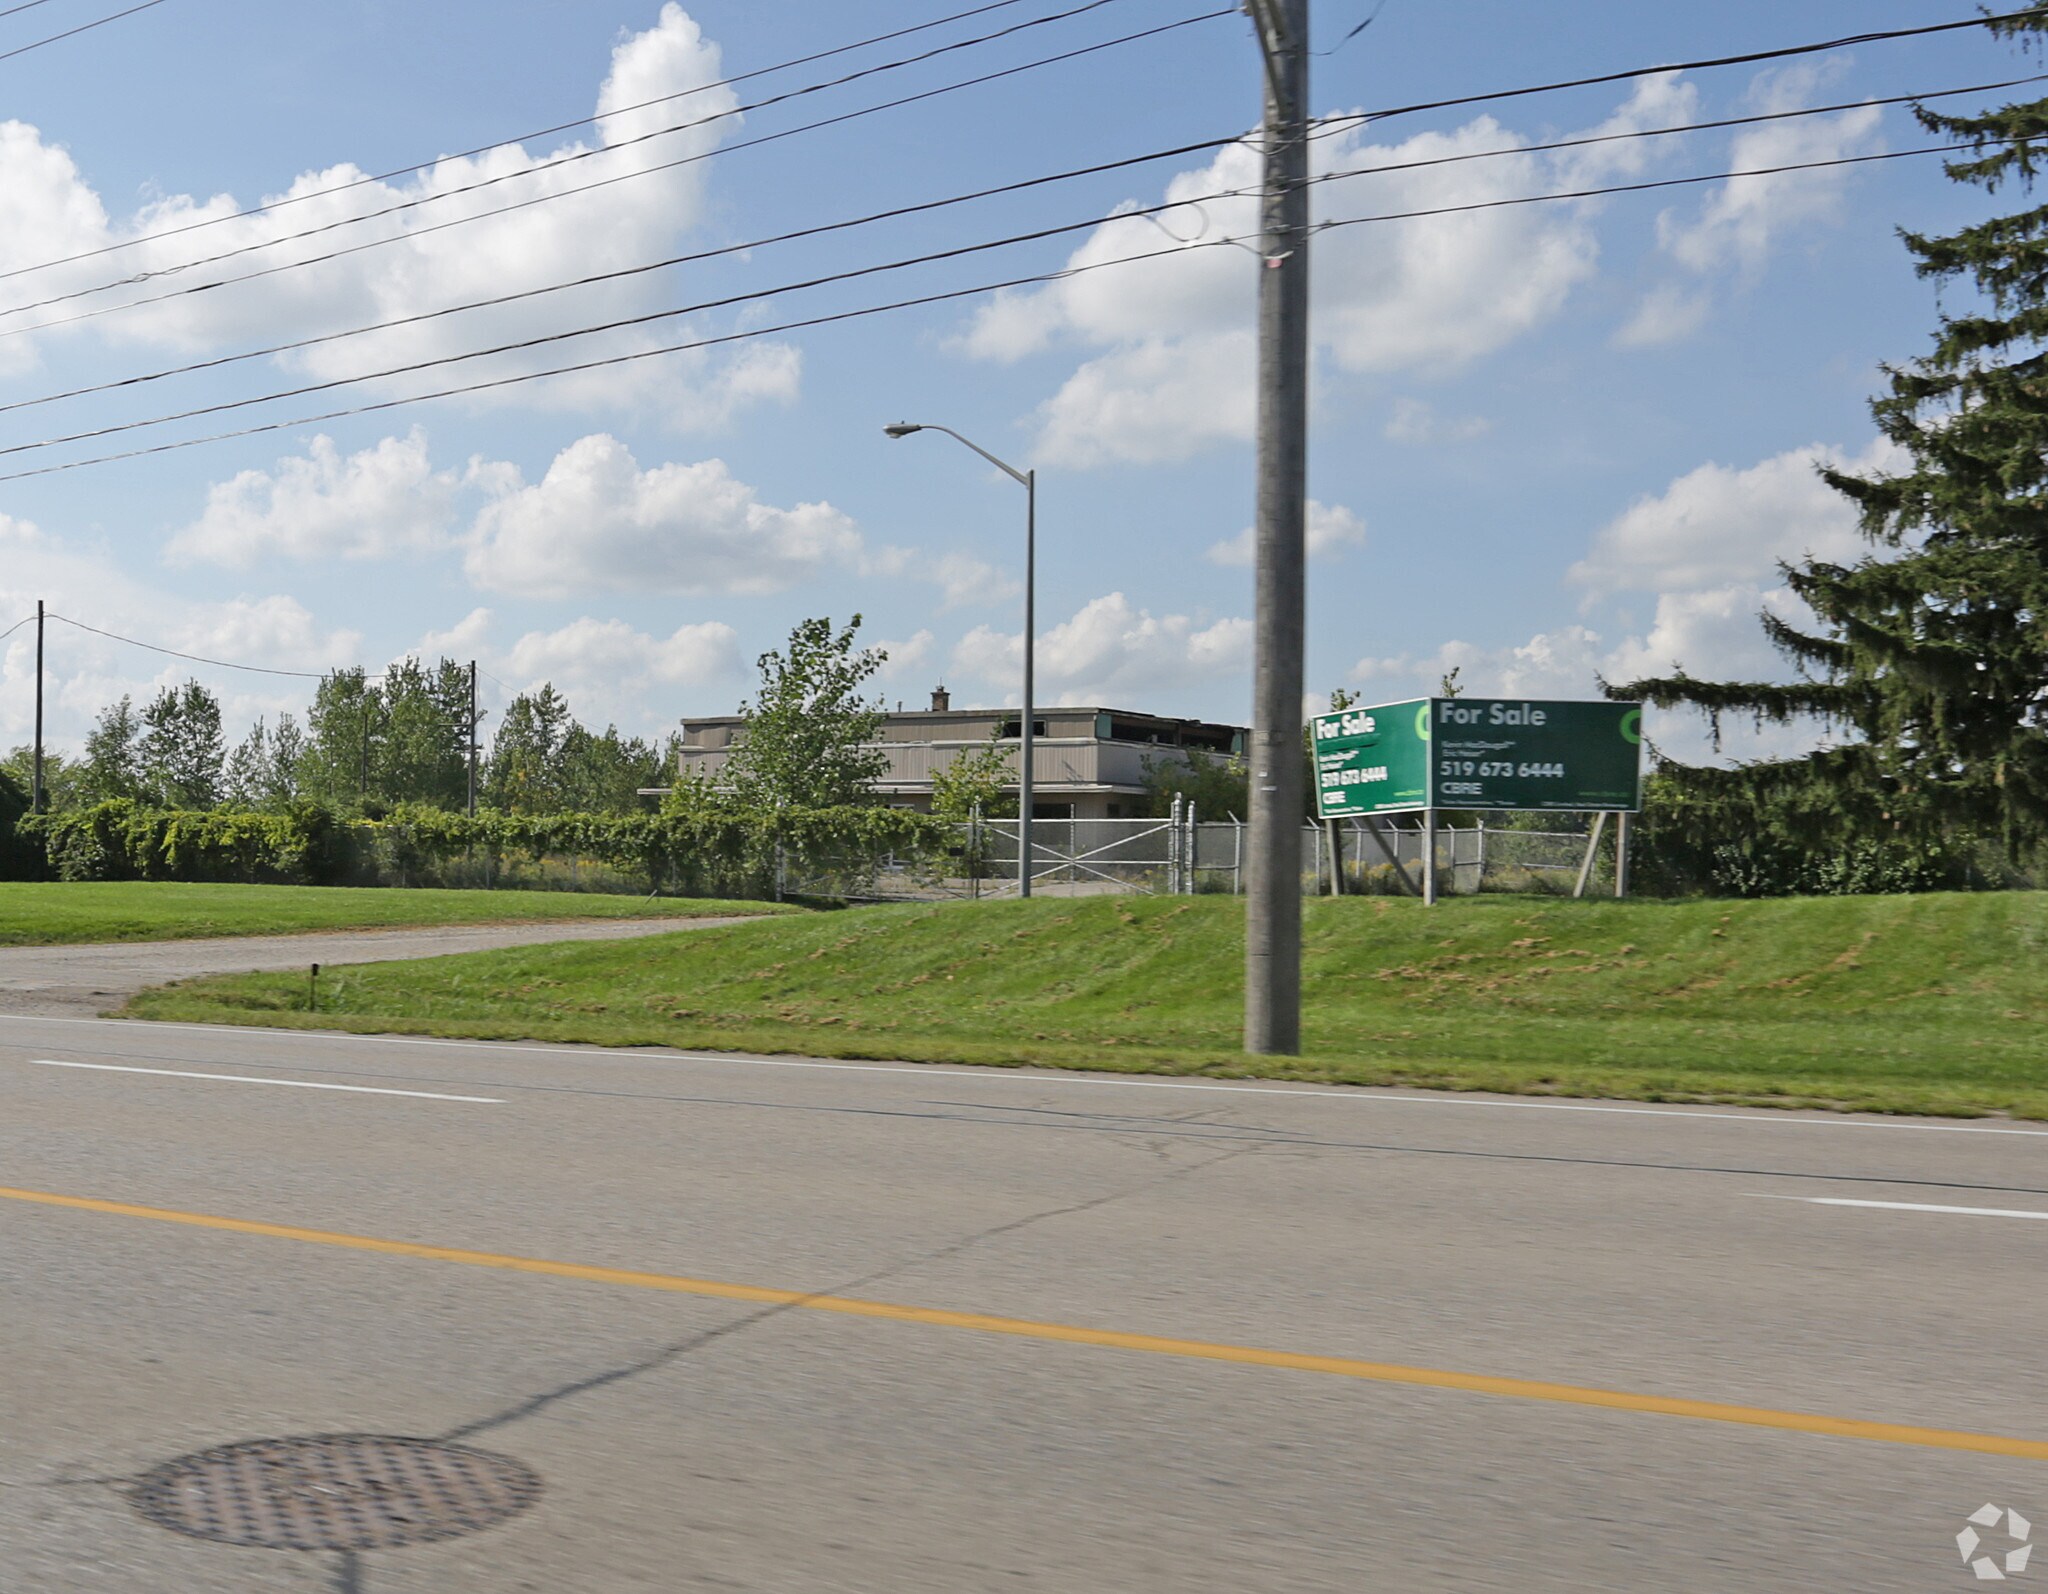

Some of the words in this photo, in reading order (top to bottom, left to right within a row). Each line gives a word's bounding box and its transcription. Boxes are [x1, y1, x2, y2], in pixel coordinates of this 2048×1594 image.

[1315, 719, 1341, 740] For
[1341, 711, 1375, 735] Sale
[1440, 702, 1482, 724] For
[1489, 703, 1547, 726] Sale
[1440, 761, 1475, 776] 519
[1479, 762, 1514, 777] 673
[1518, 763, 1565, 778] 6444
